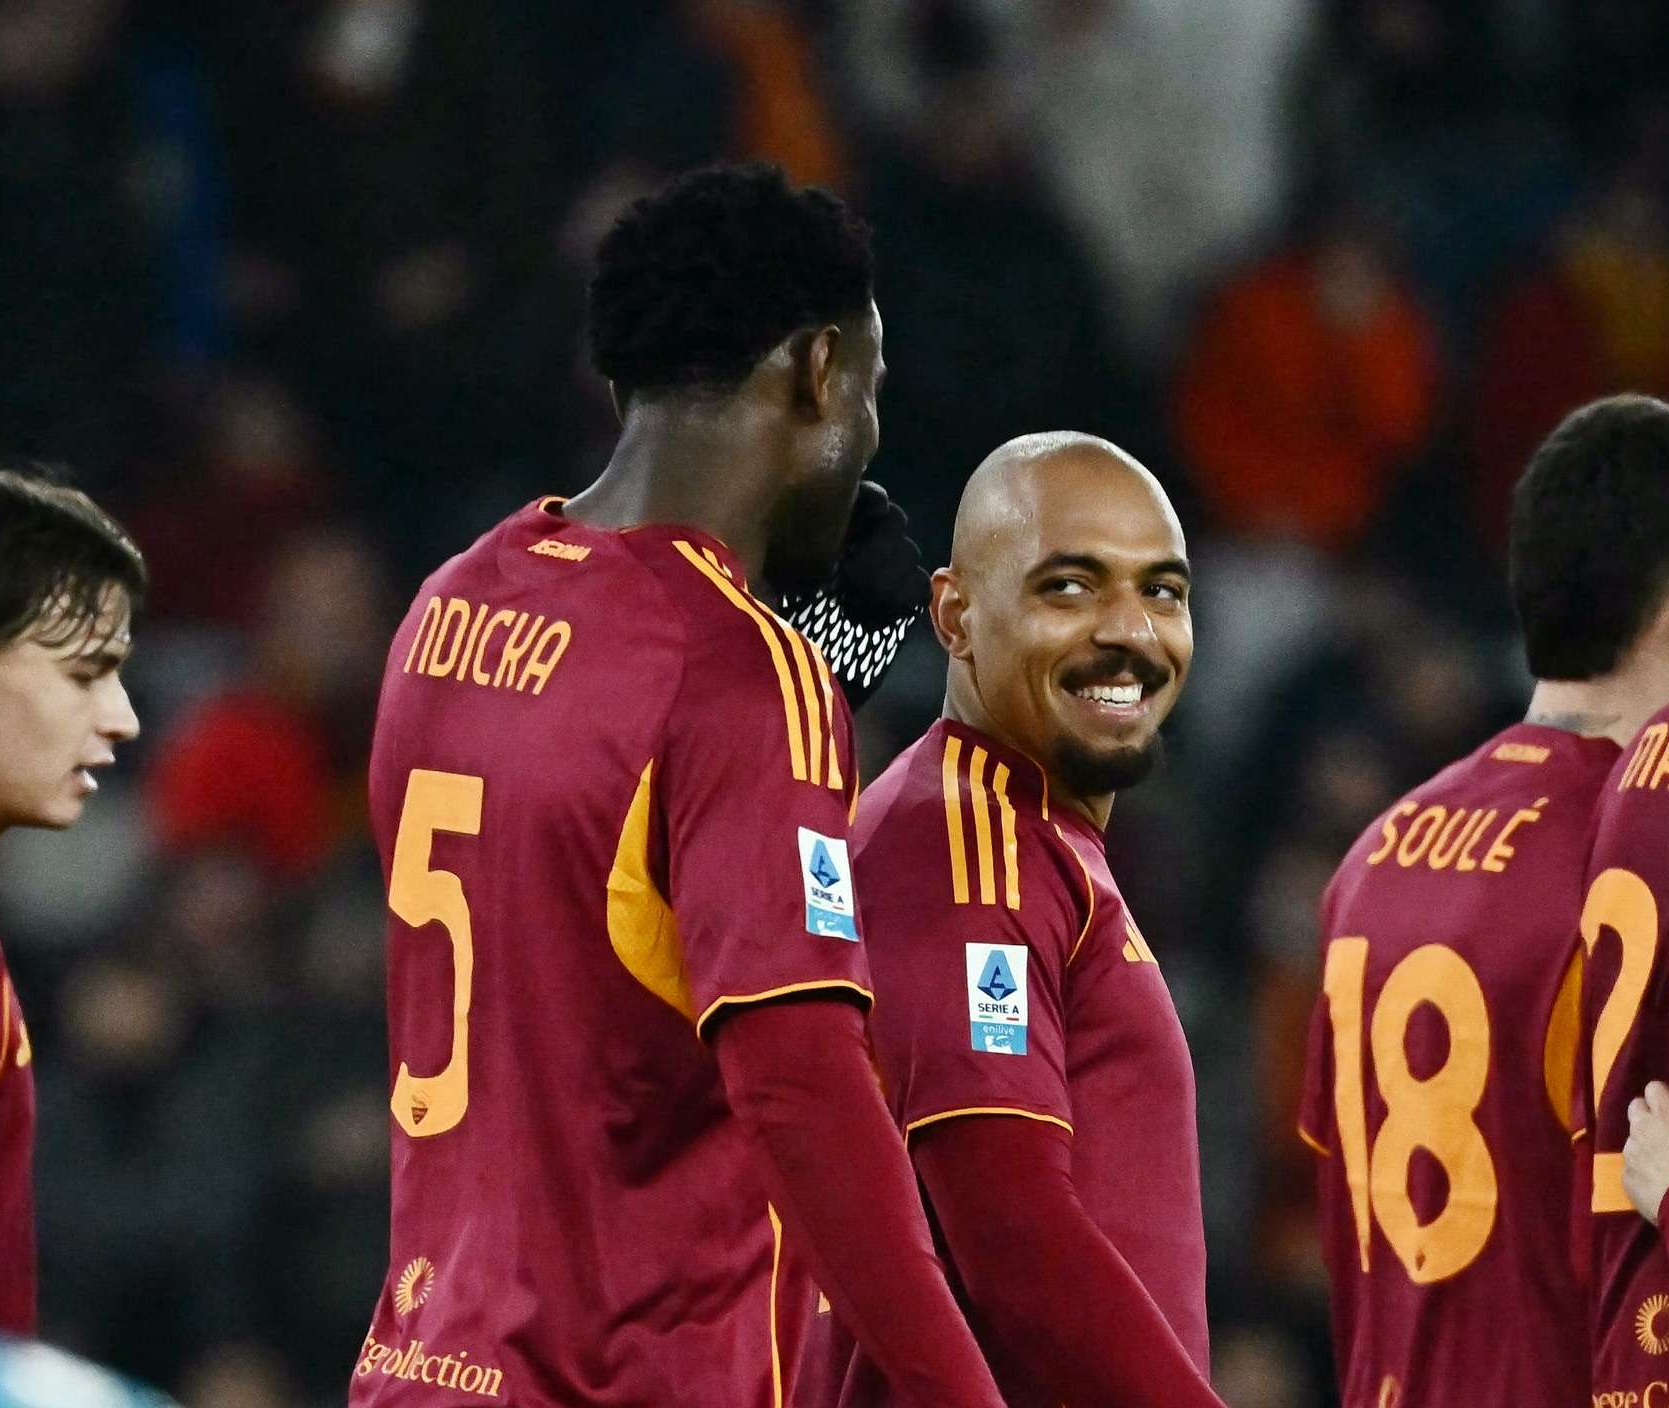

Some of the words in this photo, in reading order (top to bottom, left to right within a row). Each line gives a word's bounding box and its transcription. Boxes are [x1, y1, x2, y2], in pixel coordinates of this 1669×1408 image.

[403, 596, 571, 695] NDICKA
[1366, 798, 1540, 873] SOULÉ
[388, 768, 488, 1138] 5
[978, 1003, 1009, 1014] SERIE
[1012, 1005, 1019, 1014] A
[1323, 936, 1499, 1284] 18
